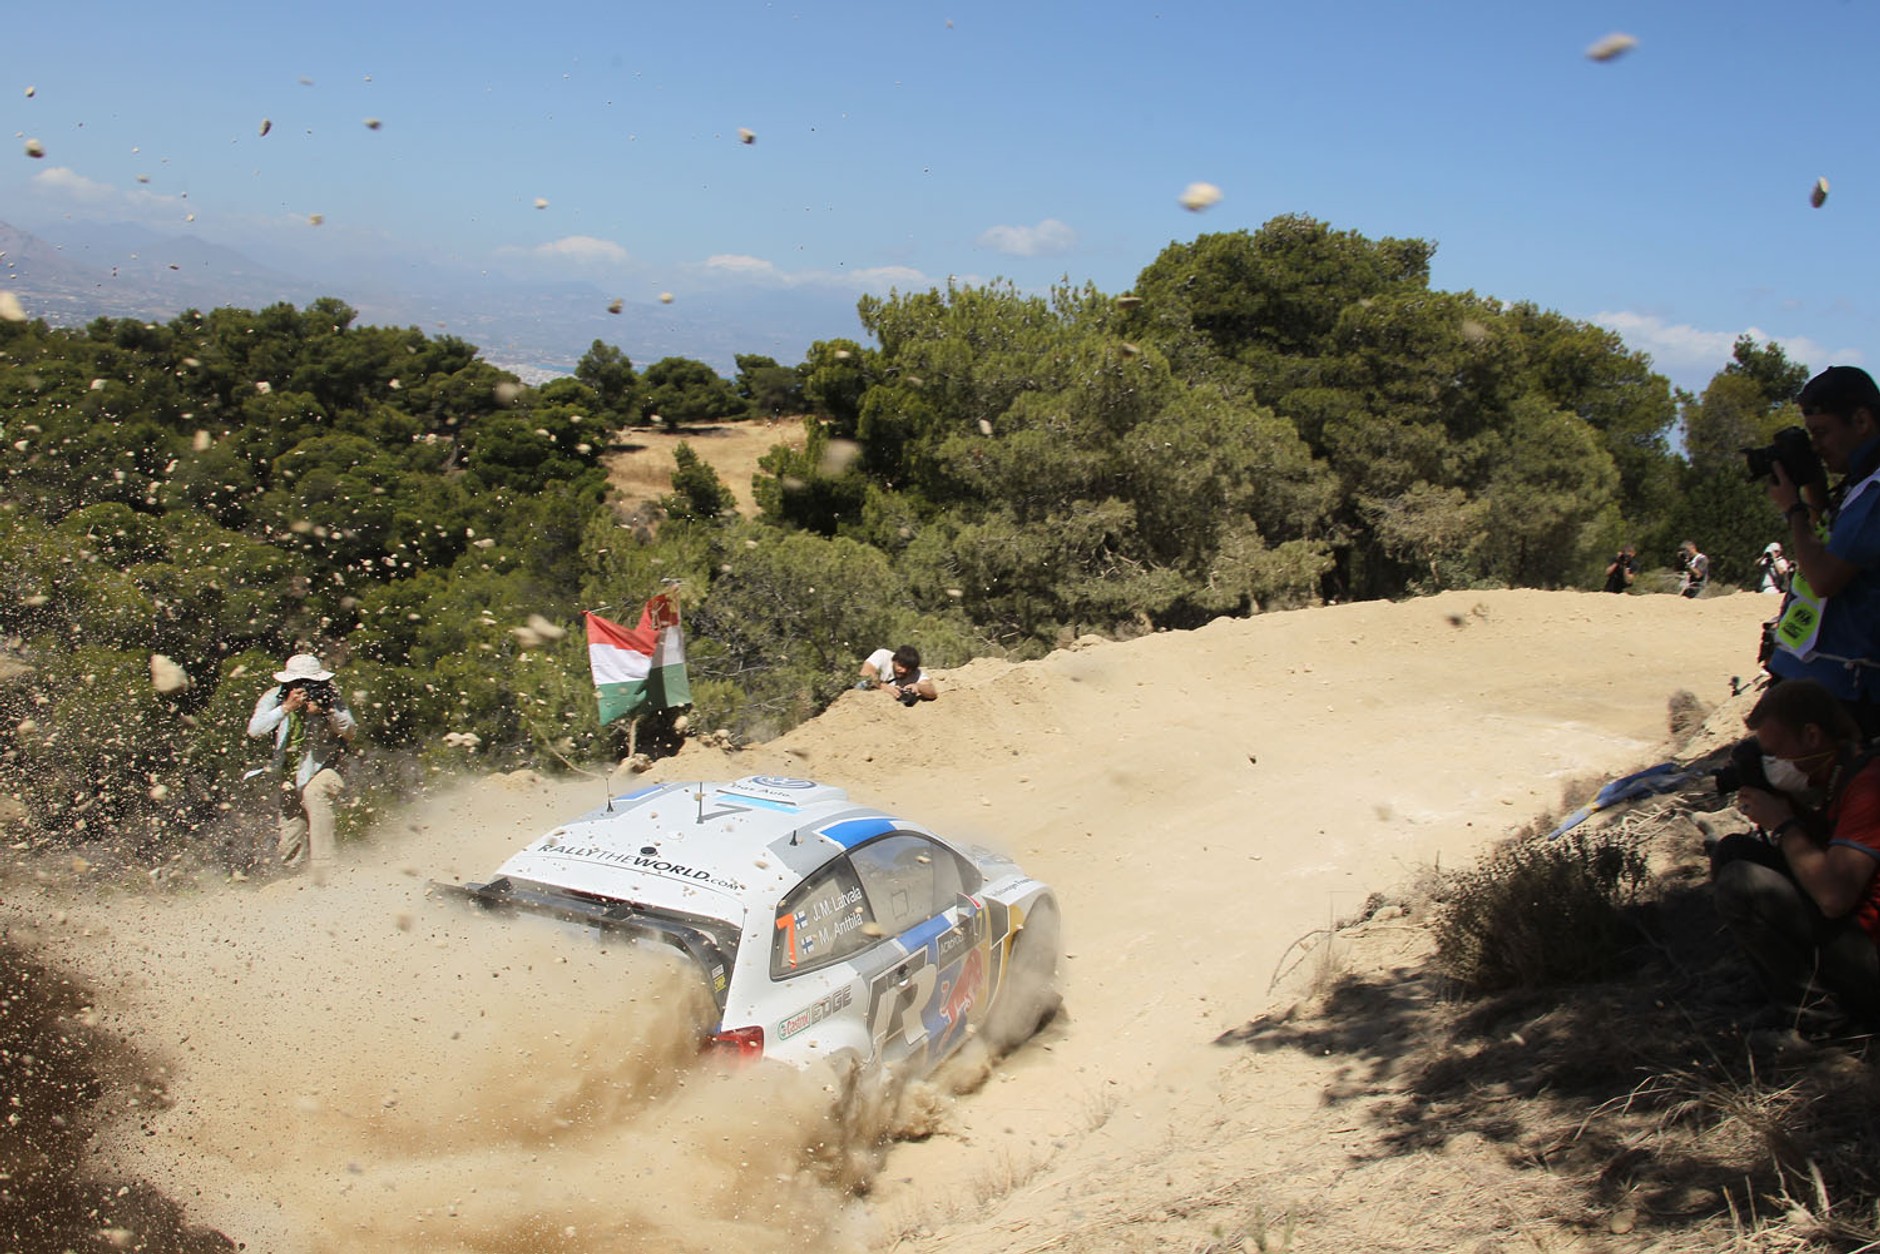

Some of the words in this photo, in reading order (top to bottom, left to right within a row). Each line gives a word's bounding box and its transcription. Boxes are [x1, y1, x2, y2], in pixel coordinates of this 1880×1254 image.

[831, 885, 863, 912] Latvala
[775, 912, 797, 969] 7
[834, 911, 863, 937] Anttila
[811, 985, 852, 1025] EDGE
[872, 963, 938, 1048] R
[784, 1010, 809, 1035] Castrol
